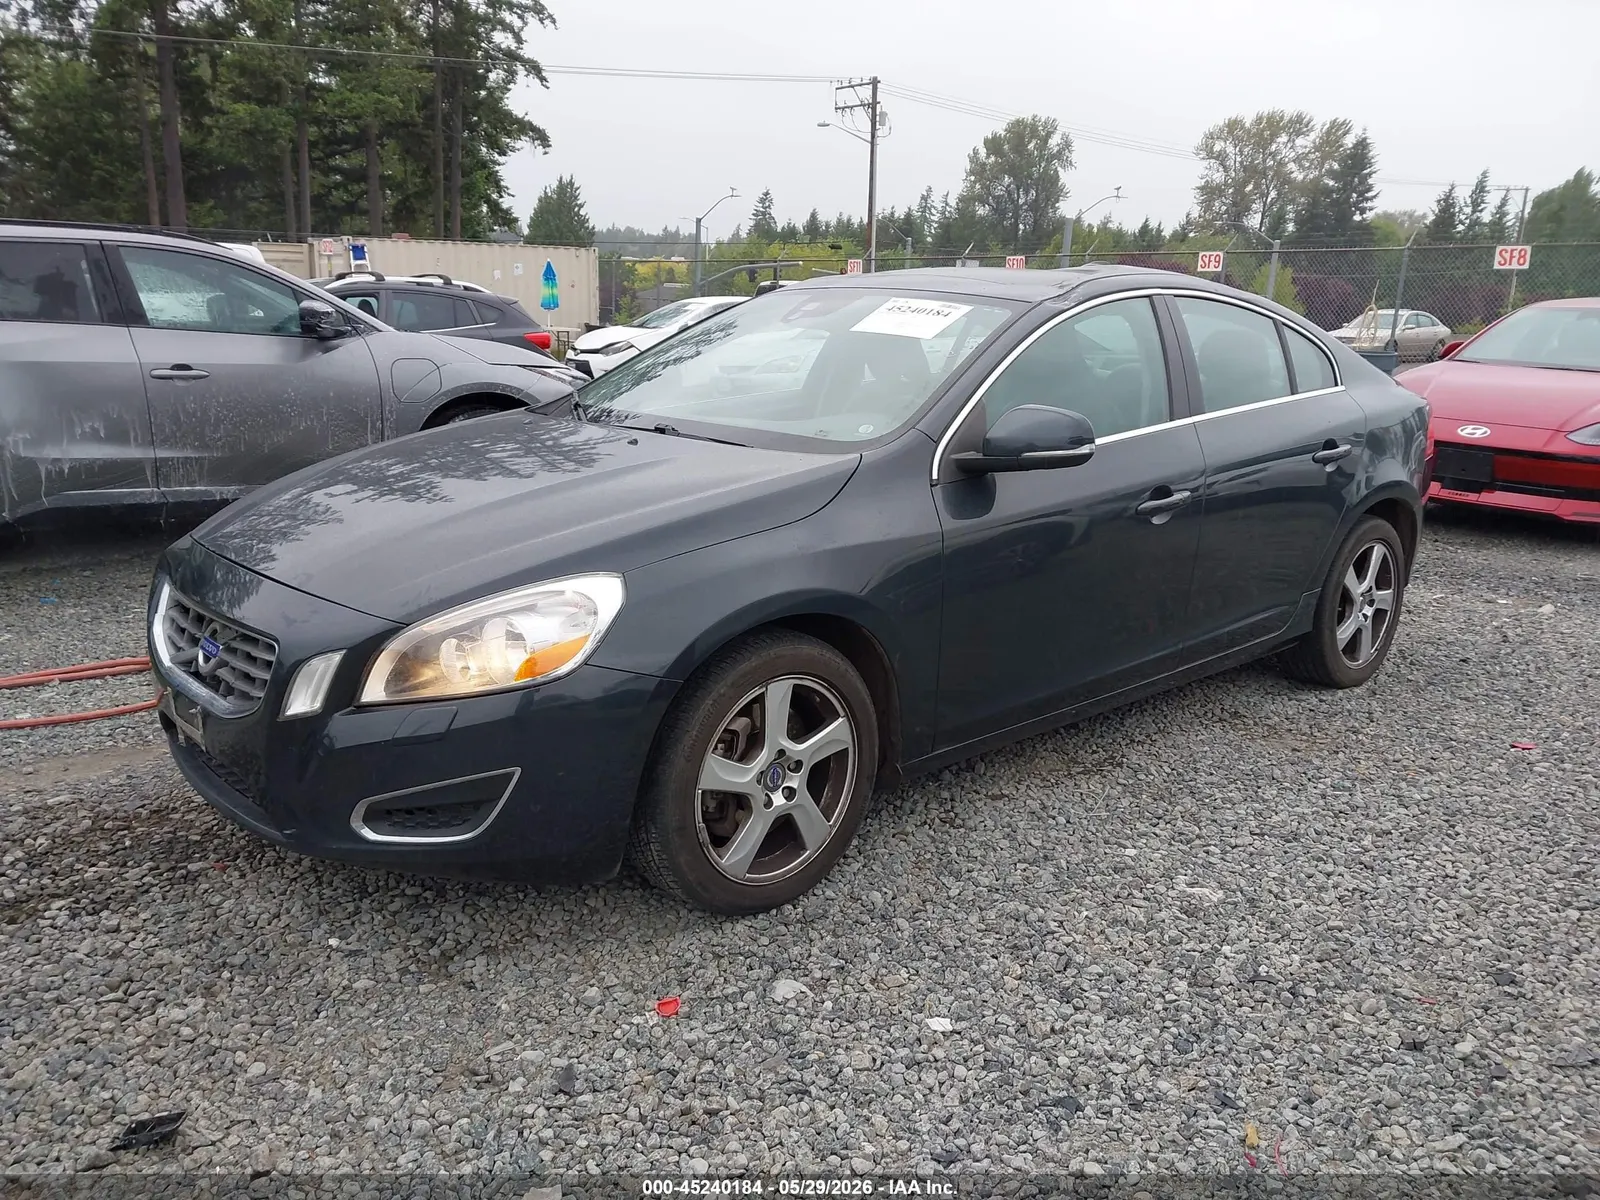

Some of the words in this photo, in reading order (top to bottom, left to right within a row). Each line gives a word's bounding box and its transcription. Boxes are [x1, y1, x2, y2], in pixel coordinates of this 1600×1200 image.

[1007, 257, 1024, 269] SF10
[1200, 254, 1221, 269] SF9
[1498, 248, 1527, 266] SF8
[849, 260, 861, 273] SF11
[886, 305, 953, 318] 45240184
